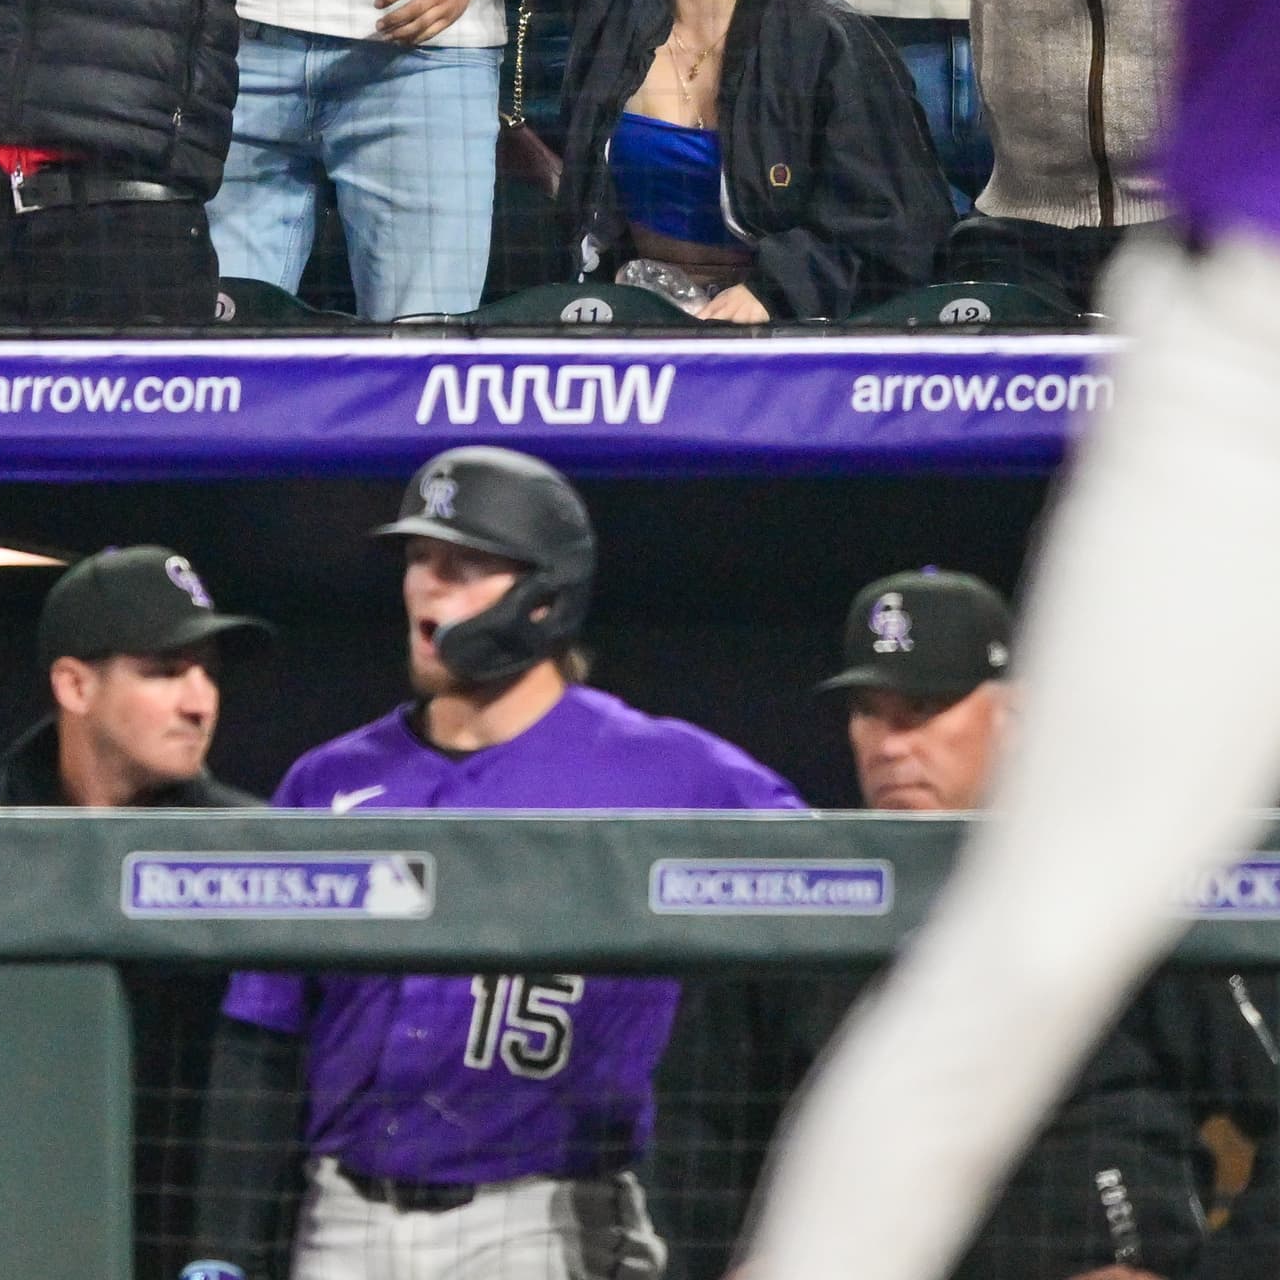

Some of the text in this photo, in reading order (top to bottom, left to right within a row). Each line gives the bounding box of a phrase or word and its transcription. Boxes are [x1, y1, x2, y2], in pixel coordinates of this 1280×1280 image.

[415, 364, 676, 426] ARROW
[850, 373, 1115, 413] arrow.com
[463, 973, 585, 1080] 15
